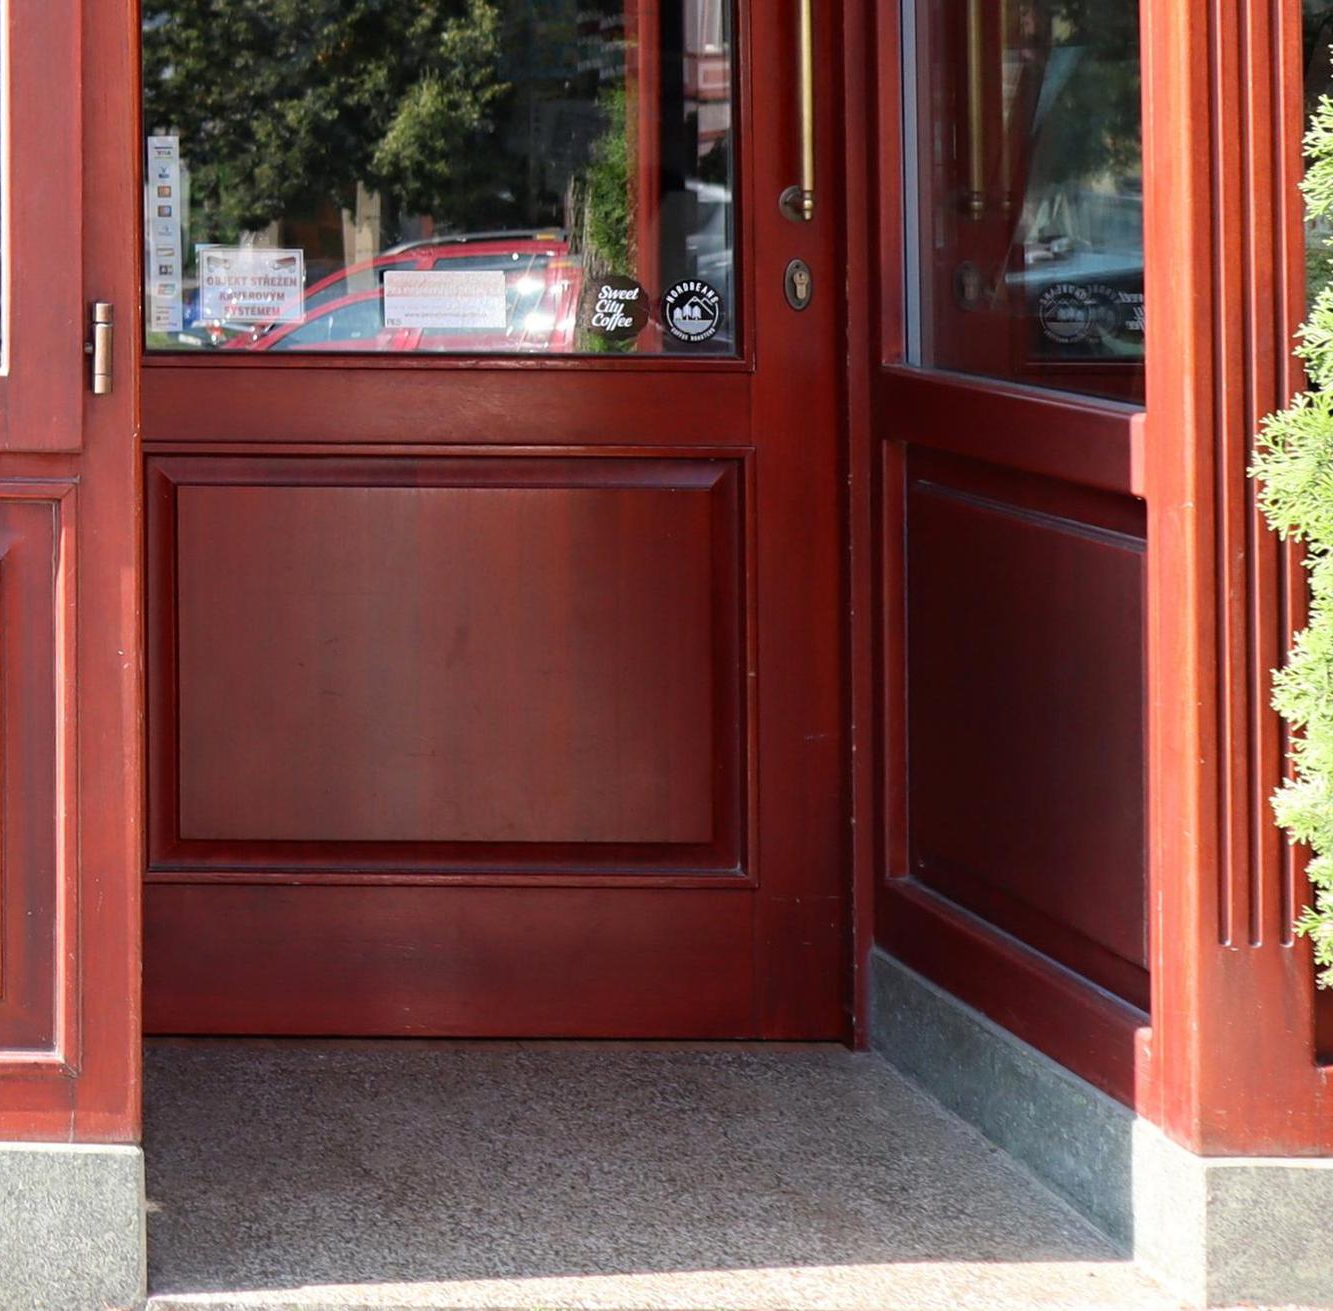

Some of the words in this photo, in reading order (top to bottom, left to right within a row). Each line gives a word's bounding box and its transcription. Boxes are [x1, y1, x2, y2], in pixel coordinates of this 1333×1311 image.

[597, 285, 640, 300] Sweet
[595, 299, 625, 317] City
[591, 312, 633, 331] Coffee
